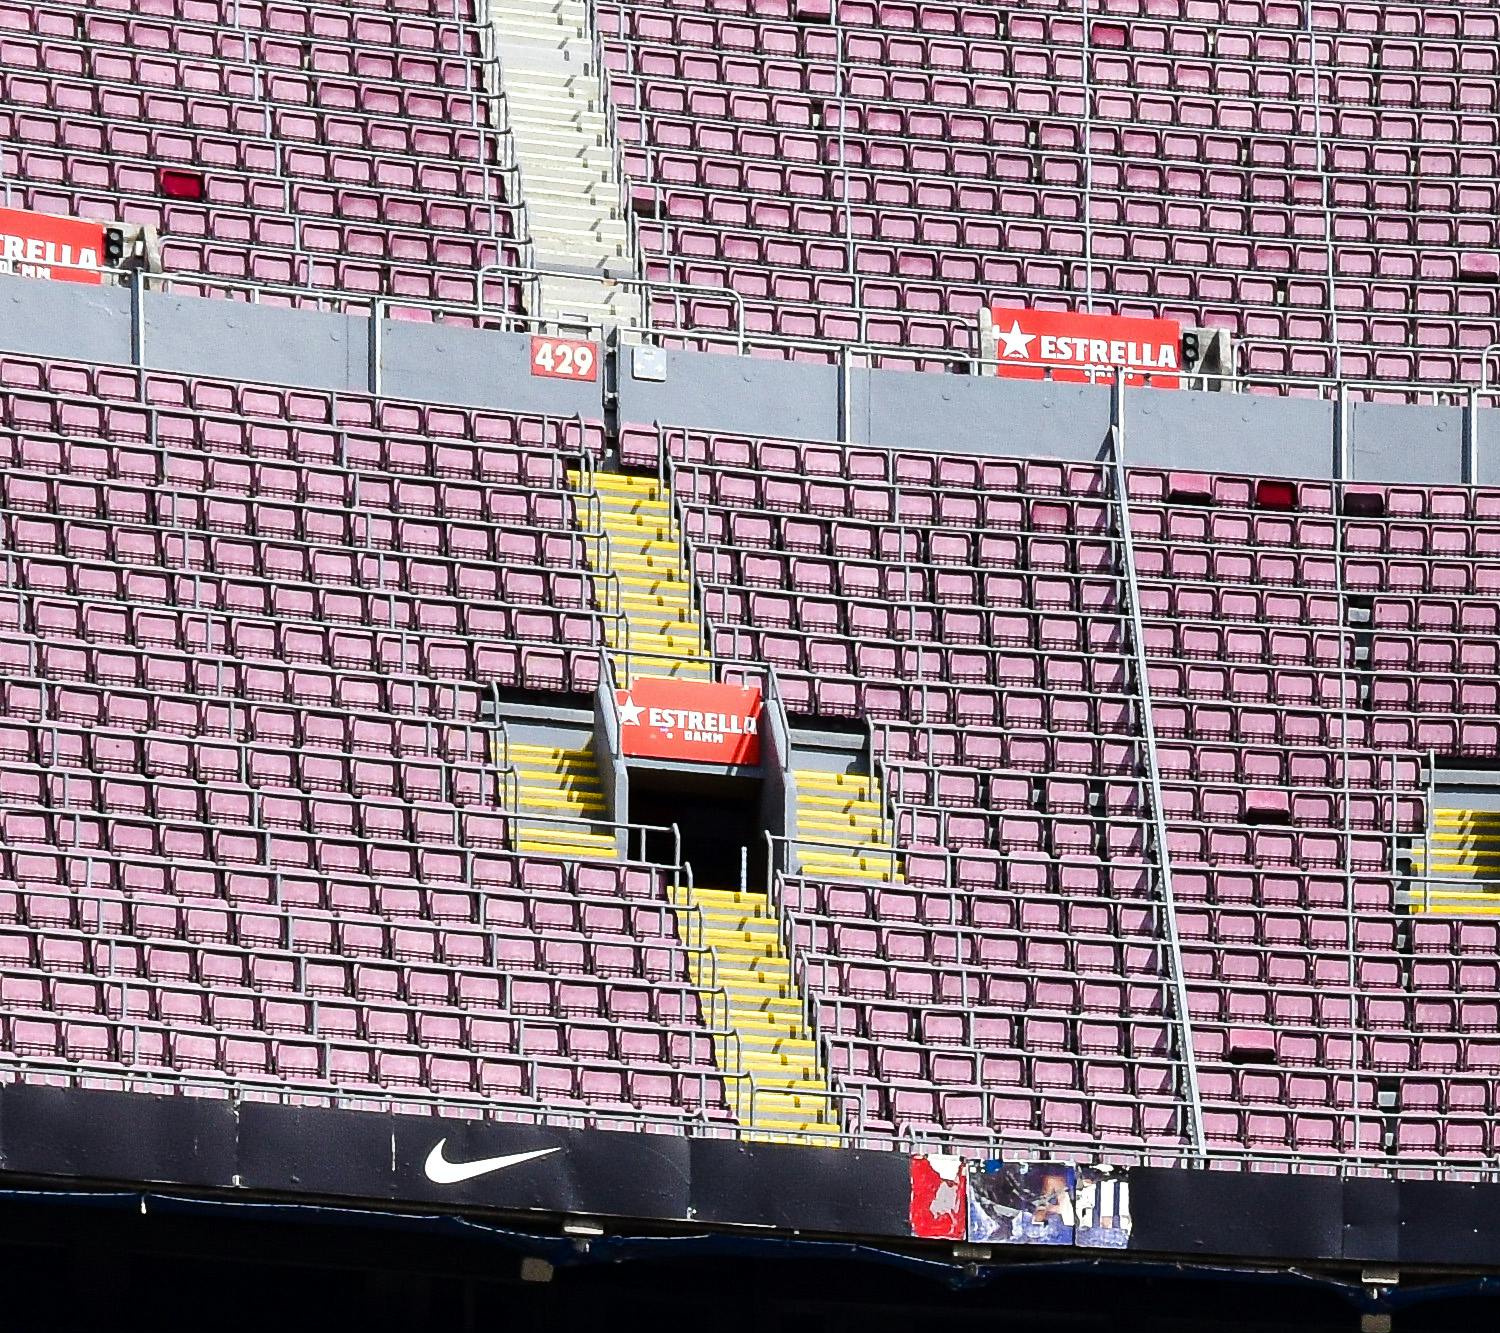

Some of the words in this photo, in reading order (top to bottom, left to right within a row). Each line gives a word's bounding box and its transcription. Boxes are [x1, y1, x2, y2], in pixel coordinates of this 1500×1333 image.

[535, 341, 593, 375] 429
[1040, 335, 1178, 368] ESTRELLA
[649, 708, 757, 734] ESTRELLA
[684, 729, 723, 744] DAMM
